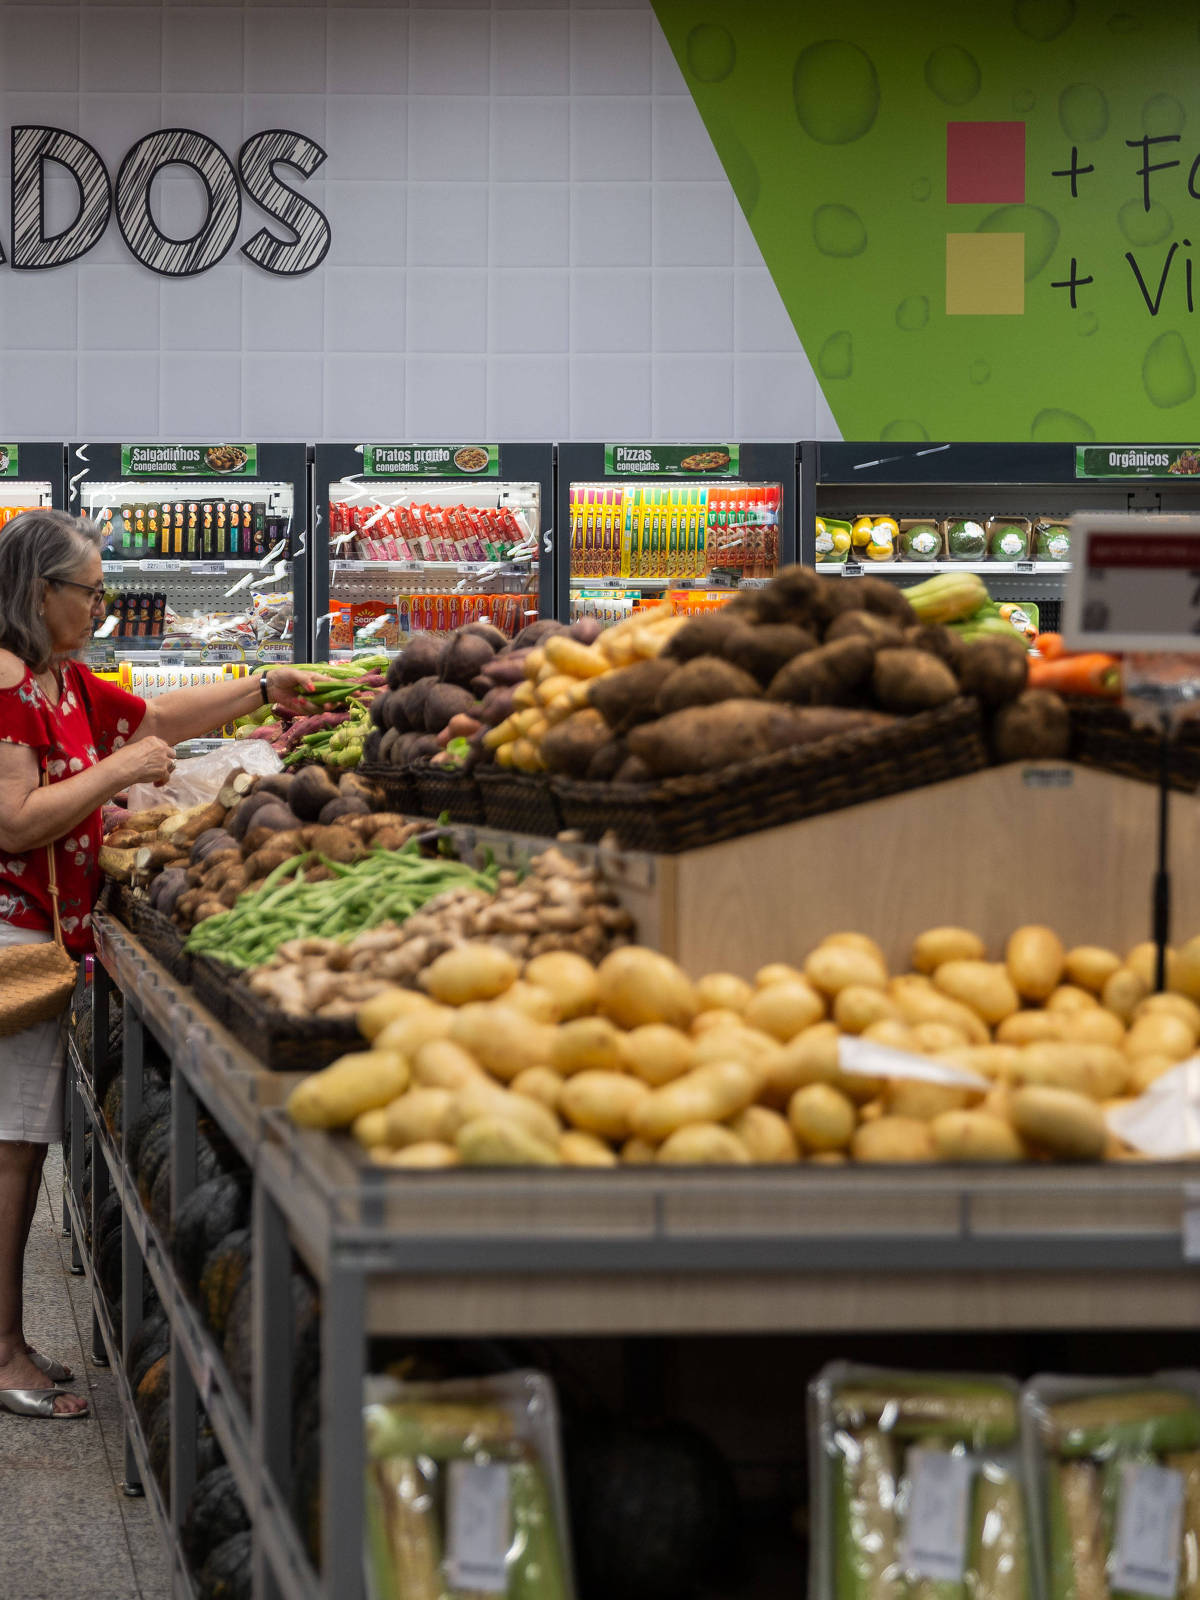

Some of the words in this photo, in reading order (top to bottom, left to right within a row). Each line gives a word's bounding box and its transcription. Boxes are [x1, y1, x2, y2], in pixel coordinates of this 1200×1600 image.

[1125, 238, 1194, 316] Vi
[133, 448, 200, 462] Salgadinhos
[375, 448, 411, 461] Pratos
[414, 448, 450, 463] pronto
[617, 447, 652, 461] Pizzas
[1109, 450, 1169, 467] Orgânicos
[133, 462, 177, 471] congelados
[375, 463, 419, 472] congeladas
[616, 462, 660, 471] congeladas
